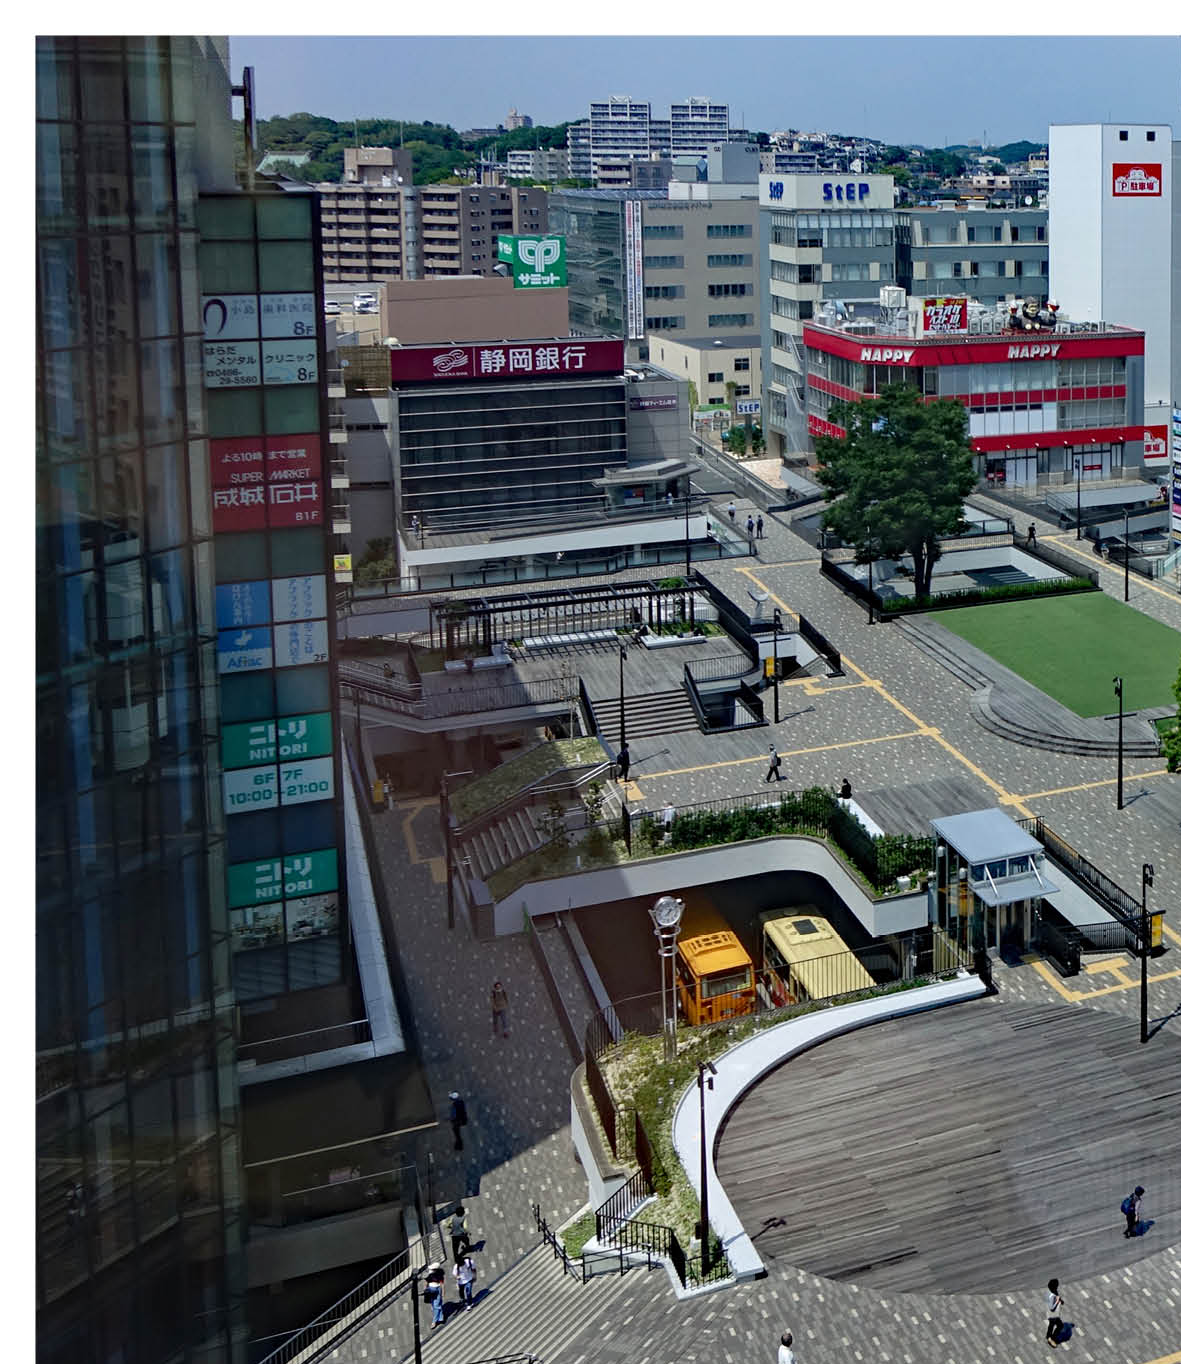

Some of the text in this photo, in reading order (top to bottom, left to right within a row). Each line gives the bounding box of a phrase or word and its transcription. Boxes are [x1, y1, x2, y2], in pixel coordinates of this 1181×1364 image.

[293, 321, 314, 336] 8F
[860, 347, 915, 362] HAPPY
[1008, 343, 1061, 359] HAPPY
[480, 346, 587, 374] 静岡銀行
[297, 367, 316, 382] 8F
[230, 467, 311, 484] SUPER MARKET
[249, 719, 307, 745] ニトリ
[250, 743, 308, 761] NITORI
[255, 856, 312, 884] ニトリ
[255, 879, 313, 899] NITORI
